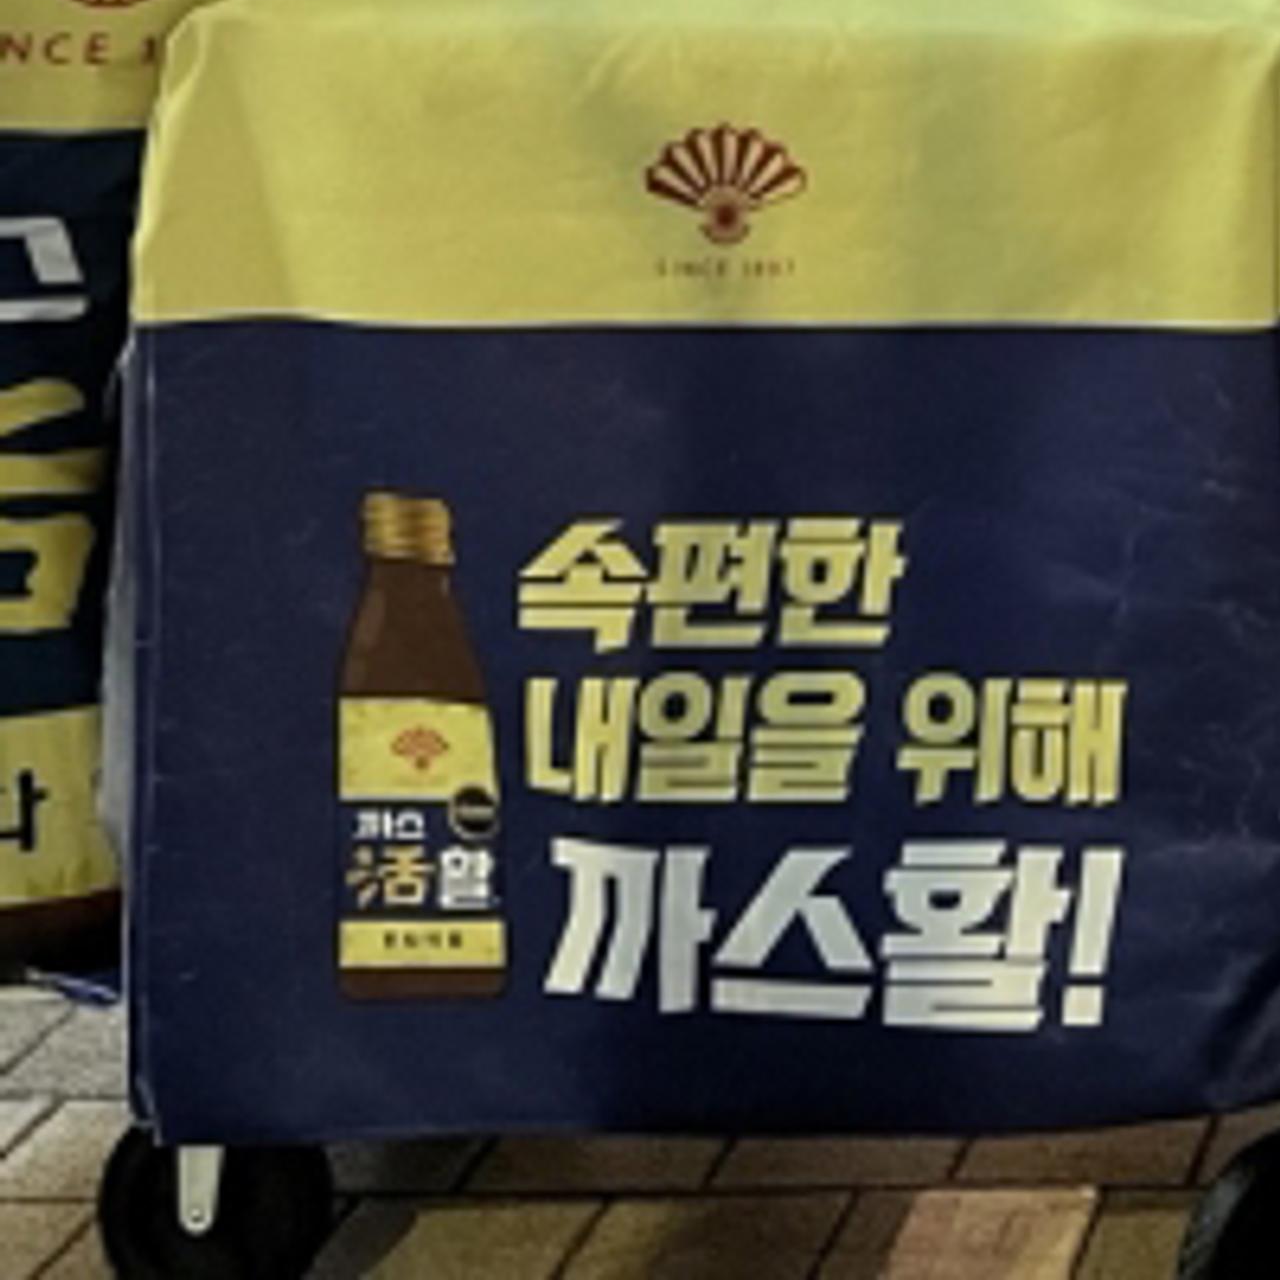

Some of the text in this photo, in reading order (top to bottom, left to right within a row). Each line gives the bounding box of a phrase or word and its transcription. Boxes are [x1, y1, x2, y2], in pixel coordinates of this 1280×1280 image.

[516, 516, 905, 653] 속편한
[523, 670, 1127, 807] 내일을 위해
[542, 837, 1125, 1031] 까스활!
